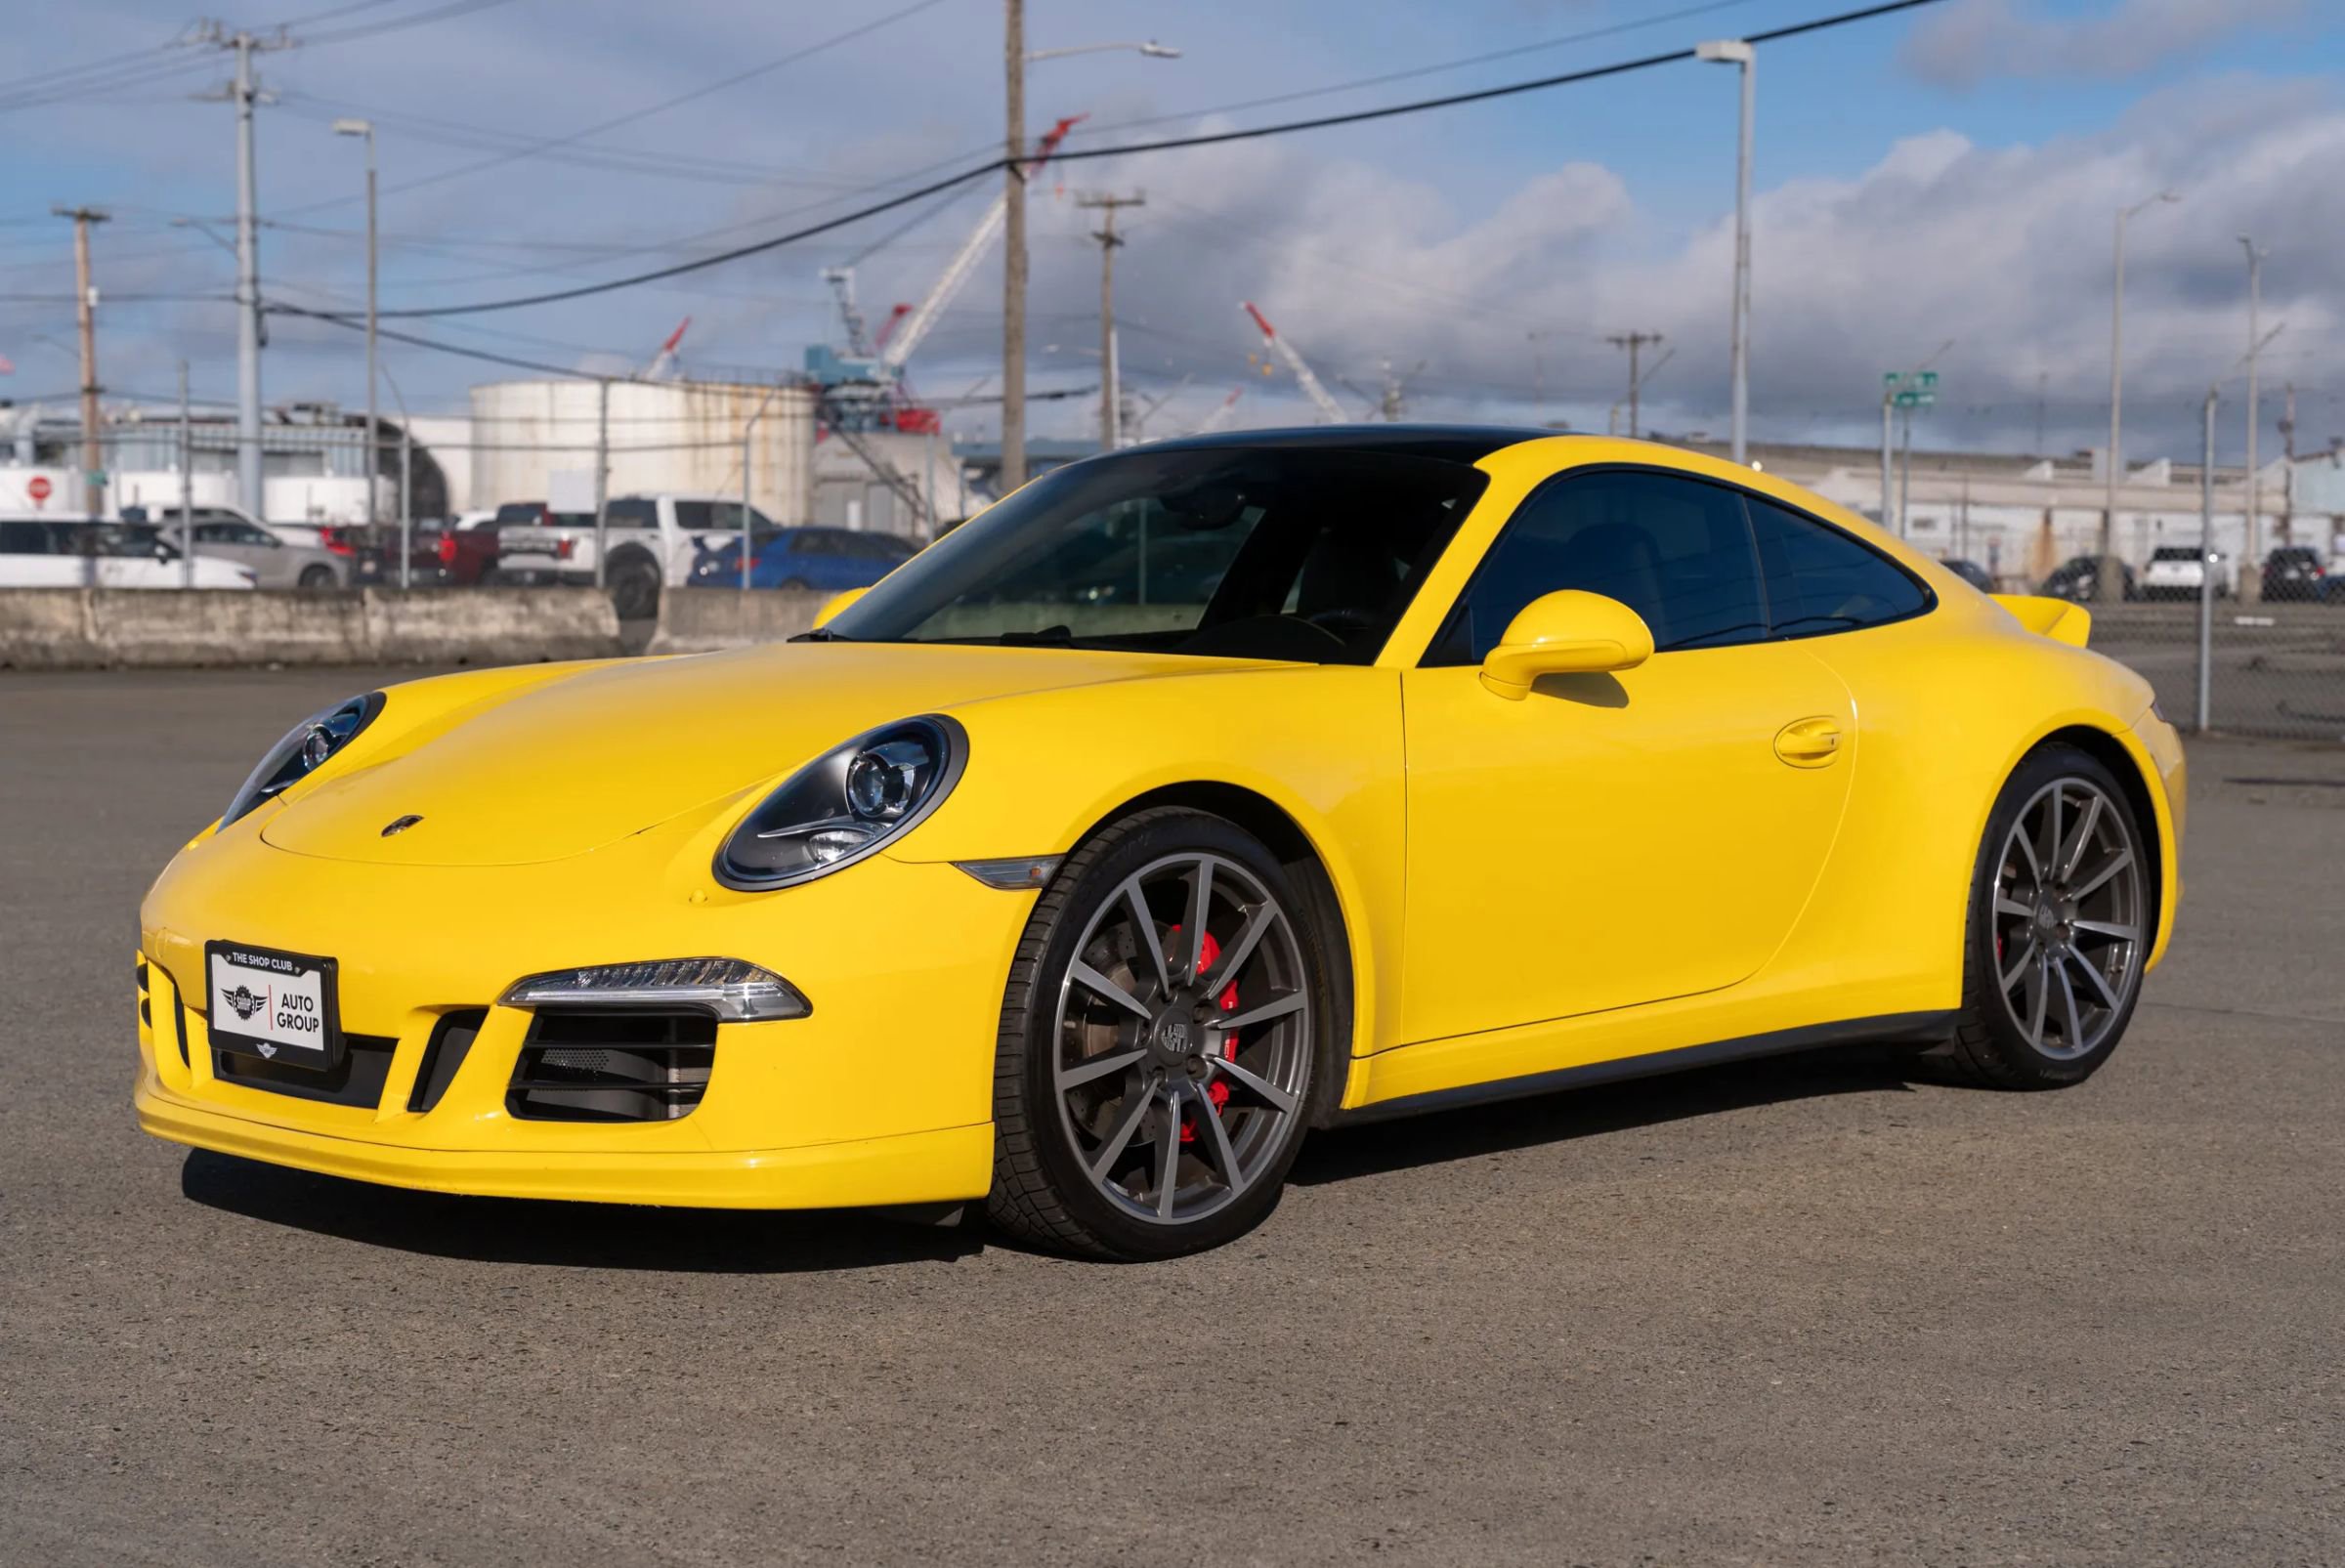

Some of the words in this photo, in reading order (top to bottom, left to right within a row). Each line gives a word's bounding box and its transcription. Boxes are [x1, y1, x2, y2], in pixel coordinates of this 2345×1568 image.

[233, 952, 248, 964] THE
[248, 954, 270, 967] SHOP
[271, 958, 293, 971] CLUB
[281, 993, 314, 1012] AUTO
[277, 1011, 320, 1033] GROUP
